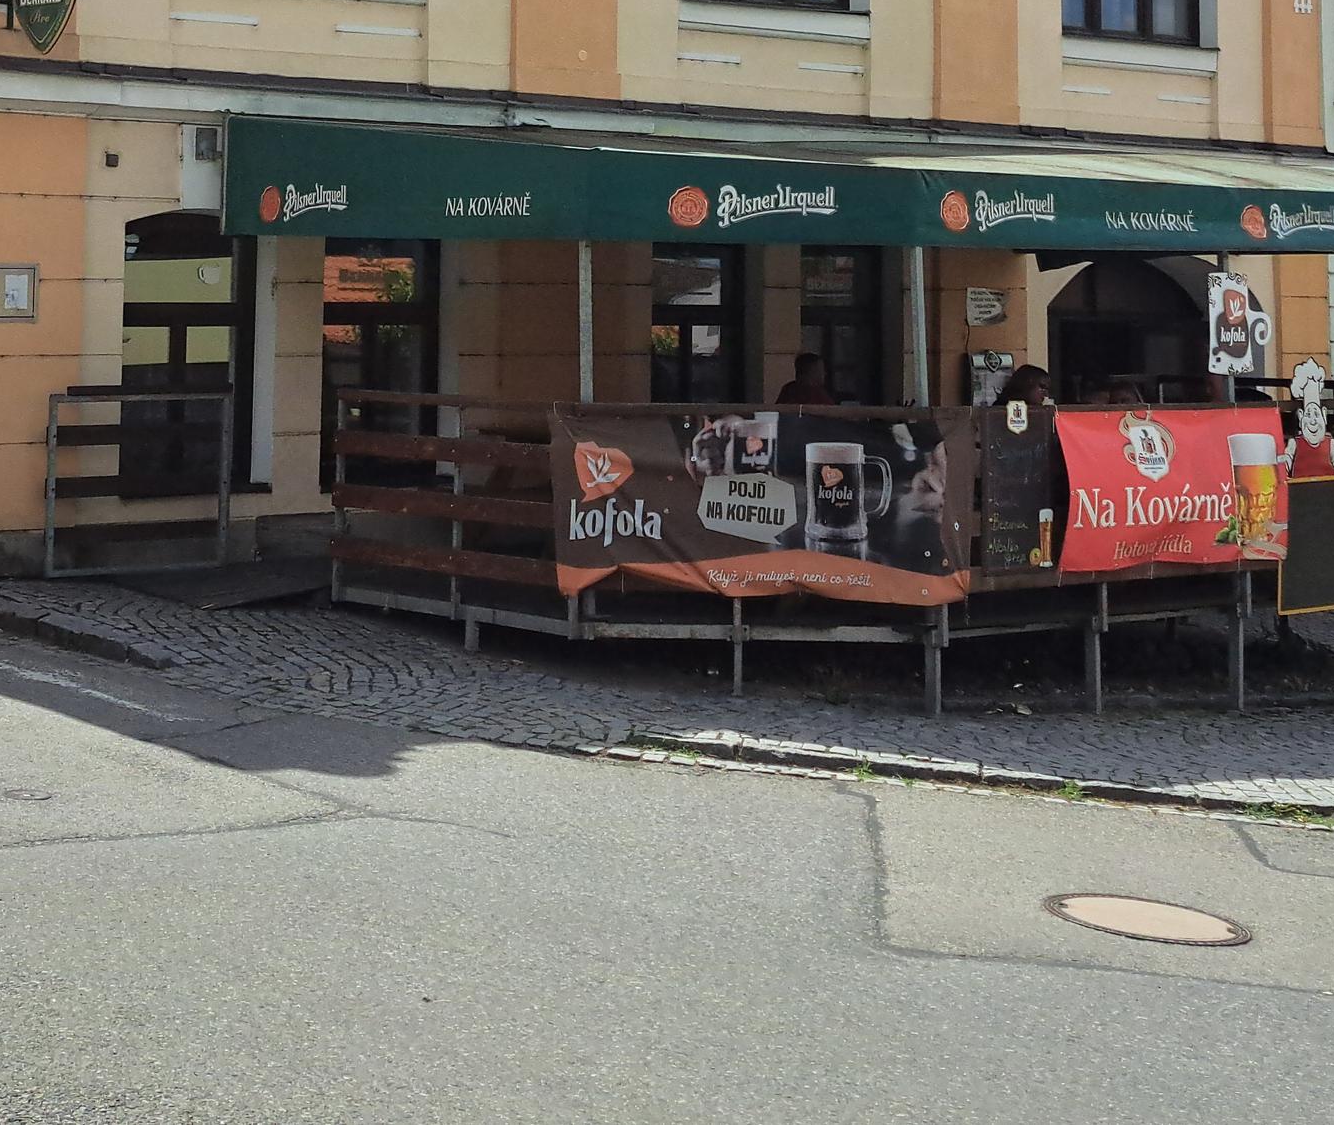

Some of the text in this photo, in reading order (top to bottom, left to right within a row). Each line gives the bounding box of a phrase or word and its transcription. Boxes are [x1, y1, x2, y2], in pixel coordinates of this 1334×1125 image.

[284, 183, 348, 222] Pilsner Urquell
[445, 191, 532, 216] NA KOVÁRNĚ
[717, 183, 835, 228] Pilsner Urquell
[974, 190, 1055, 232] Pilsner Urquell
[1105, 208, 1199, 232] NA KOVÁRNĚ
[1270, 203, 1304, 240] Pilsner
[1220, 327, 1246, 346] kofola
[728, 480, 766, 499] POJĎ
[818, 485, 854, 504] kofola
[706, 501, 785, 525] NA KOFOLU
[1073, 487, 1117, 529] Na
[1124, 482, 1234, 527] Kovárně
[569, 497, 662, 547] kofola
[706, 569, 739, 588] Když
[755, 569, 800, 587] miluješ,
[802, 570, 827, 584] není
[829, 574, 843, 584] co
